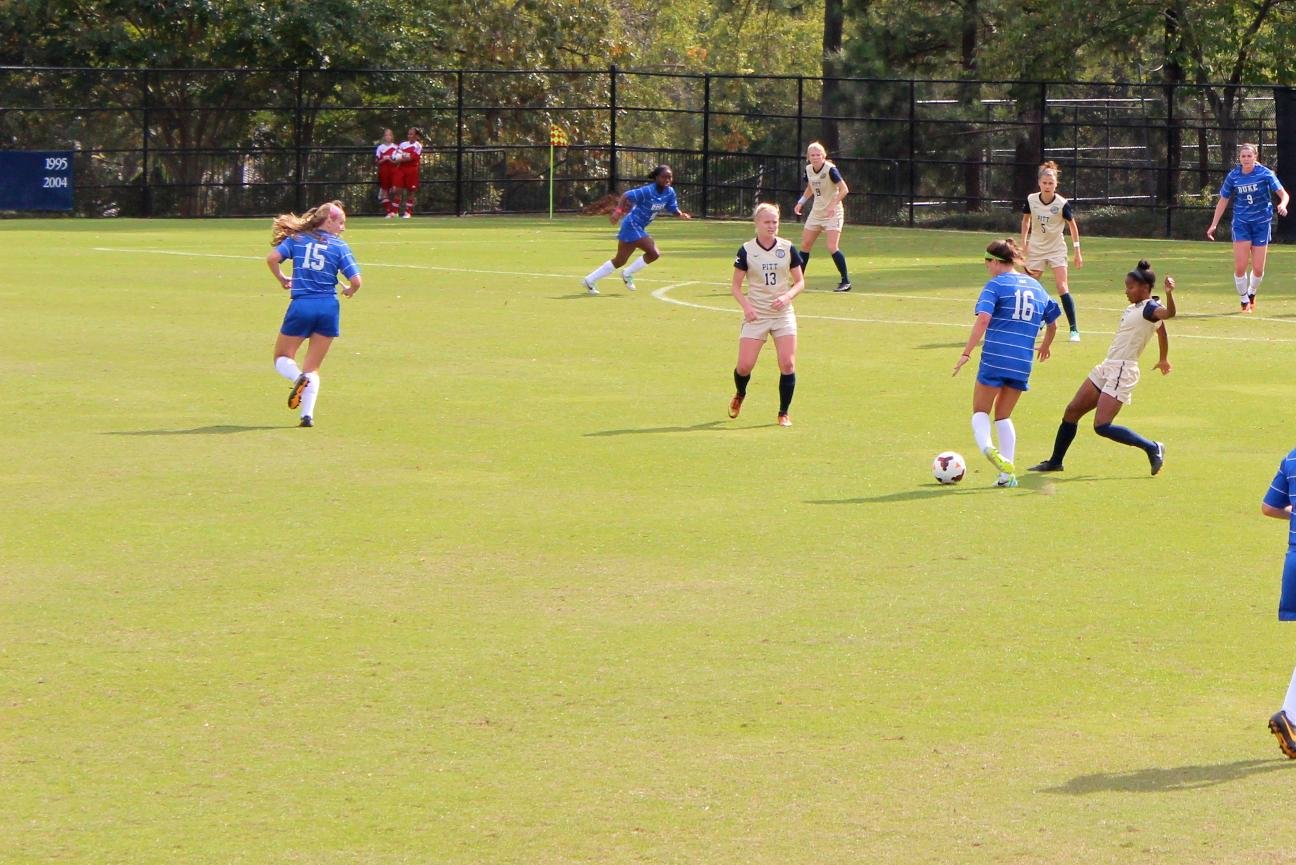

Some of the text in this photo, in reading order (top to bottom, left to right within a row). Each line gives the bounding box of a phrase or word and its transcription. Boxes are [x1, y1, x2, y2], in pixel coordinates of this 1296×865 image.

[45, 157, 68, 170] 1995
[43, 177, 68, 188] 2004
[1237, 183, 1259, 194] DUKE
[1246, 194, 1254, 205] 9
[1040, 223, 1046, 234] 5
[302, 242, 328, 271] 15
[761, 263, 779, 271] PITT
[764, 272, 777, 286] 13
[1012, 288, 1035, 321] 16
